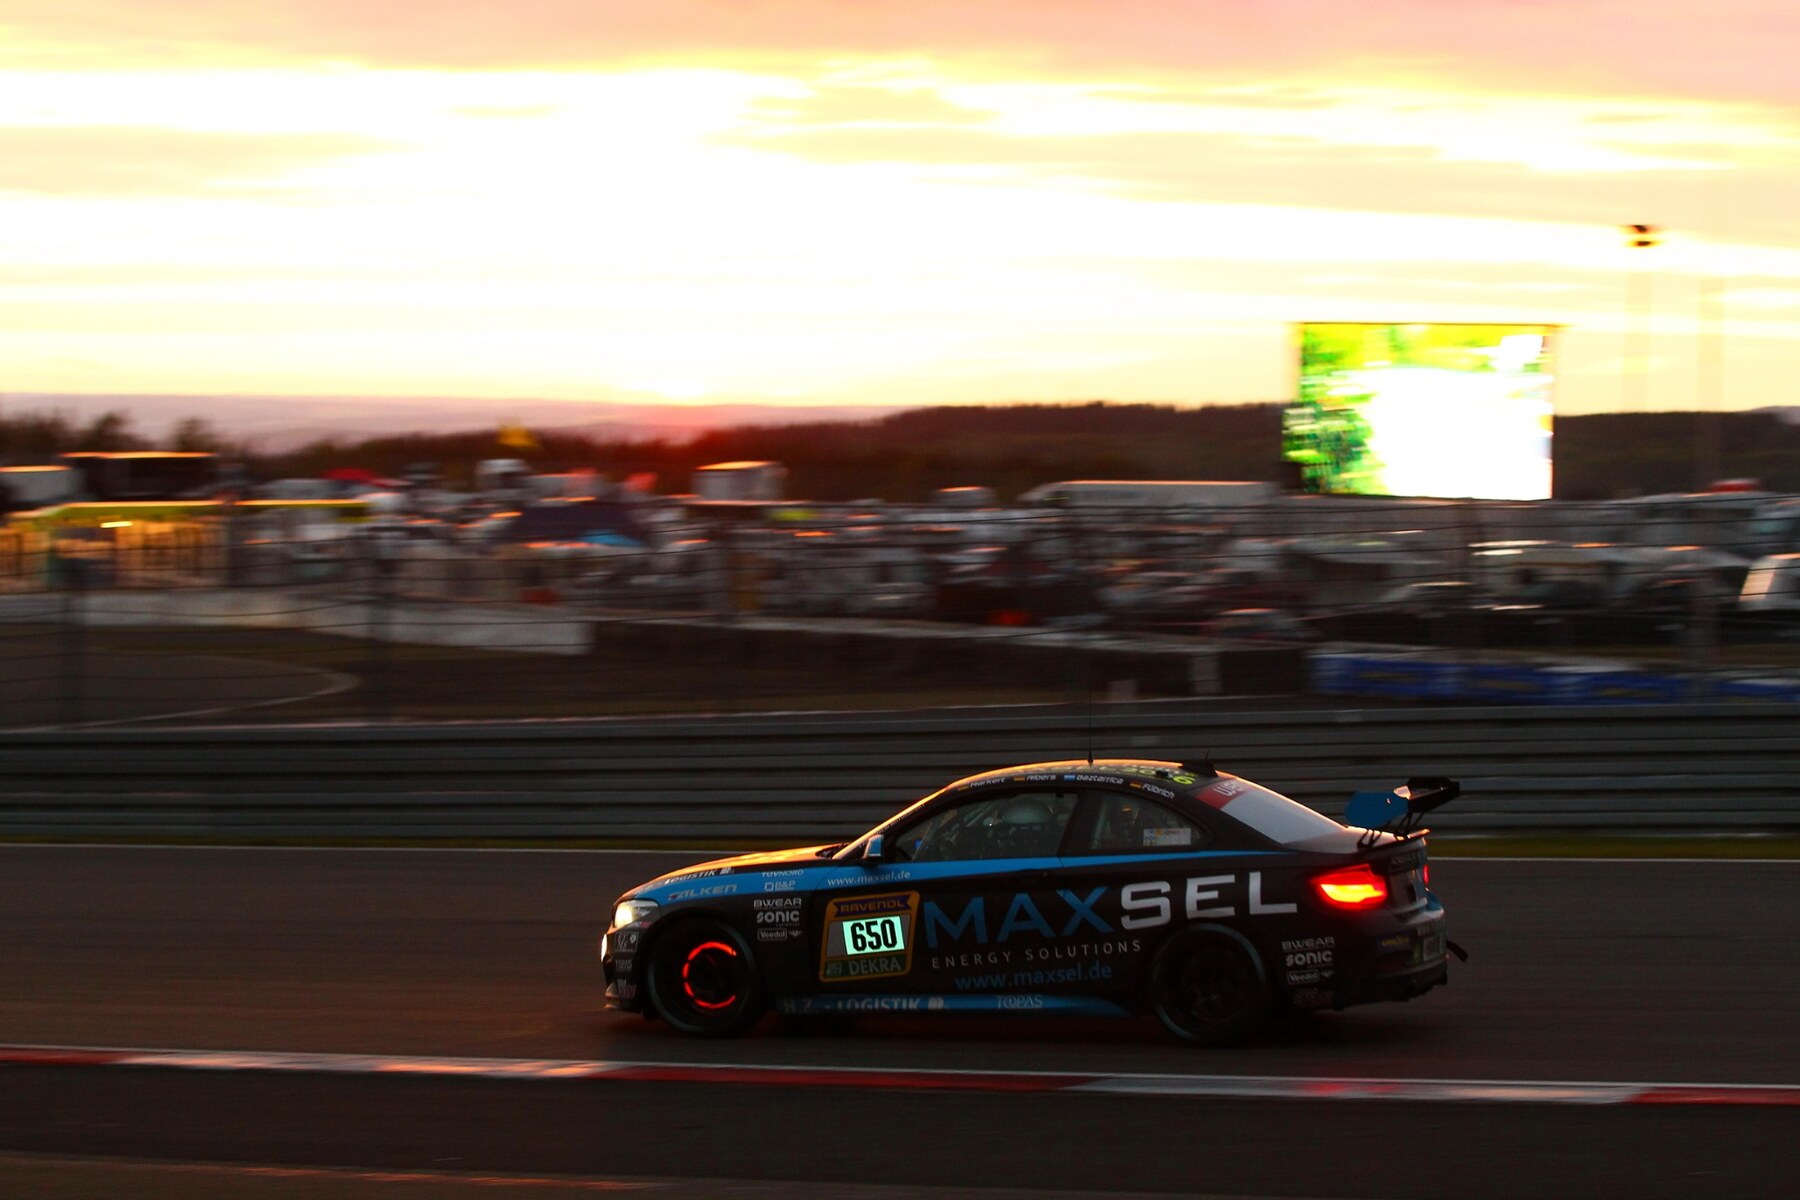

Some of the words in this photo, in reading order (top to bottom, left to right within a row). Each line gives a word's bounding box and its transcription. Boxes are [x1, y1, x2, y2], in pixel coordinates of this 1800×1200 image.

[664, 869, 717, 885] LOGISTIK
[827, 869, 911, 887] www.maxsel.de
[667, 883, 738, 901] FALKEN
[840, 899, 904, 913] RAVENOL
[922, 871, 1298, 949] MAXSEL
[759, 929, 785, 939] Veedol
[850, 919, 898, 952] 650
[931, 951, 1012, 970] ENERGY
[1025, 939, 1141, 962] SOLUTIONS
[848, 957, 901, 976] DEKRA
[954, 961, 1112, 991] www.maxsel.de
[837, 997, 922, 1011] LOGISTIK
[996, 994, 1043, 1009] TOPAS
